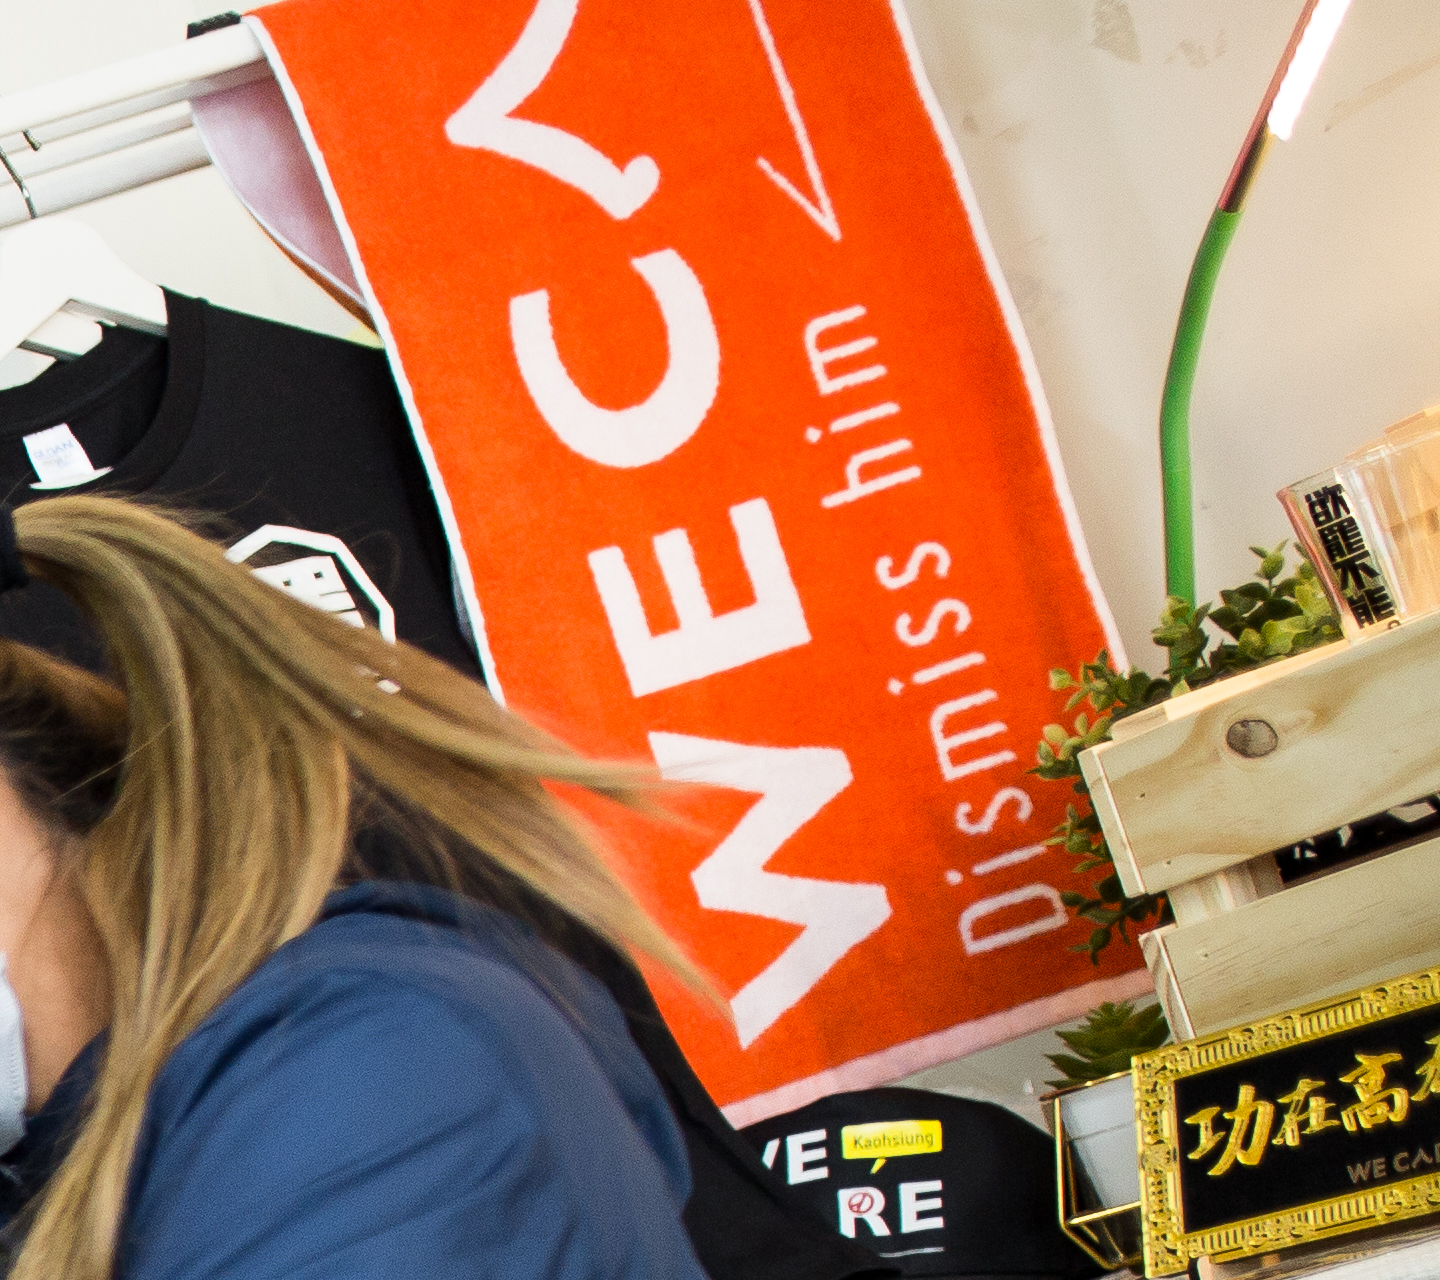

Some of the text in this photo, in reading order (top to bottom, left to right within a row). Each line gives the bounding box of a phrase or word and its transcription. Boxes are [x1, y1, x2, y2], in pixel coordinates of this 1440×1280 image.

[1304, 483, 1396, 630] 欲罷不能
[803, 305, 1069, 956] Dismiss him
[852, 1129, 936, 1151] Kaohsiung
[1347, 1157, 1387, 1184] WE
